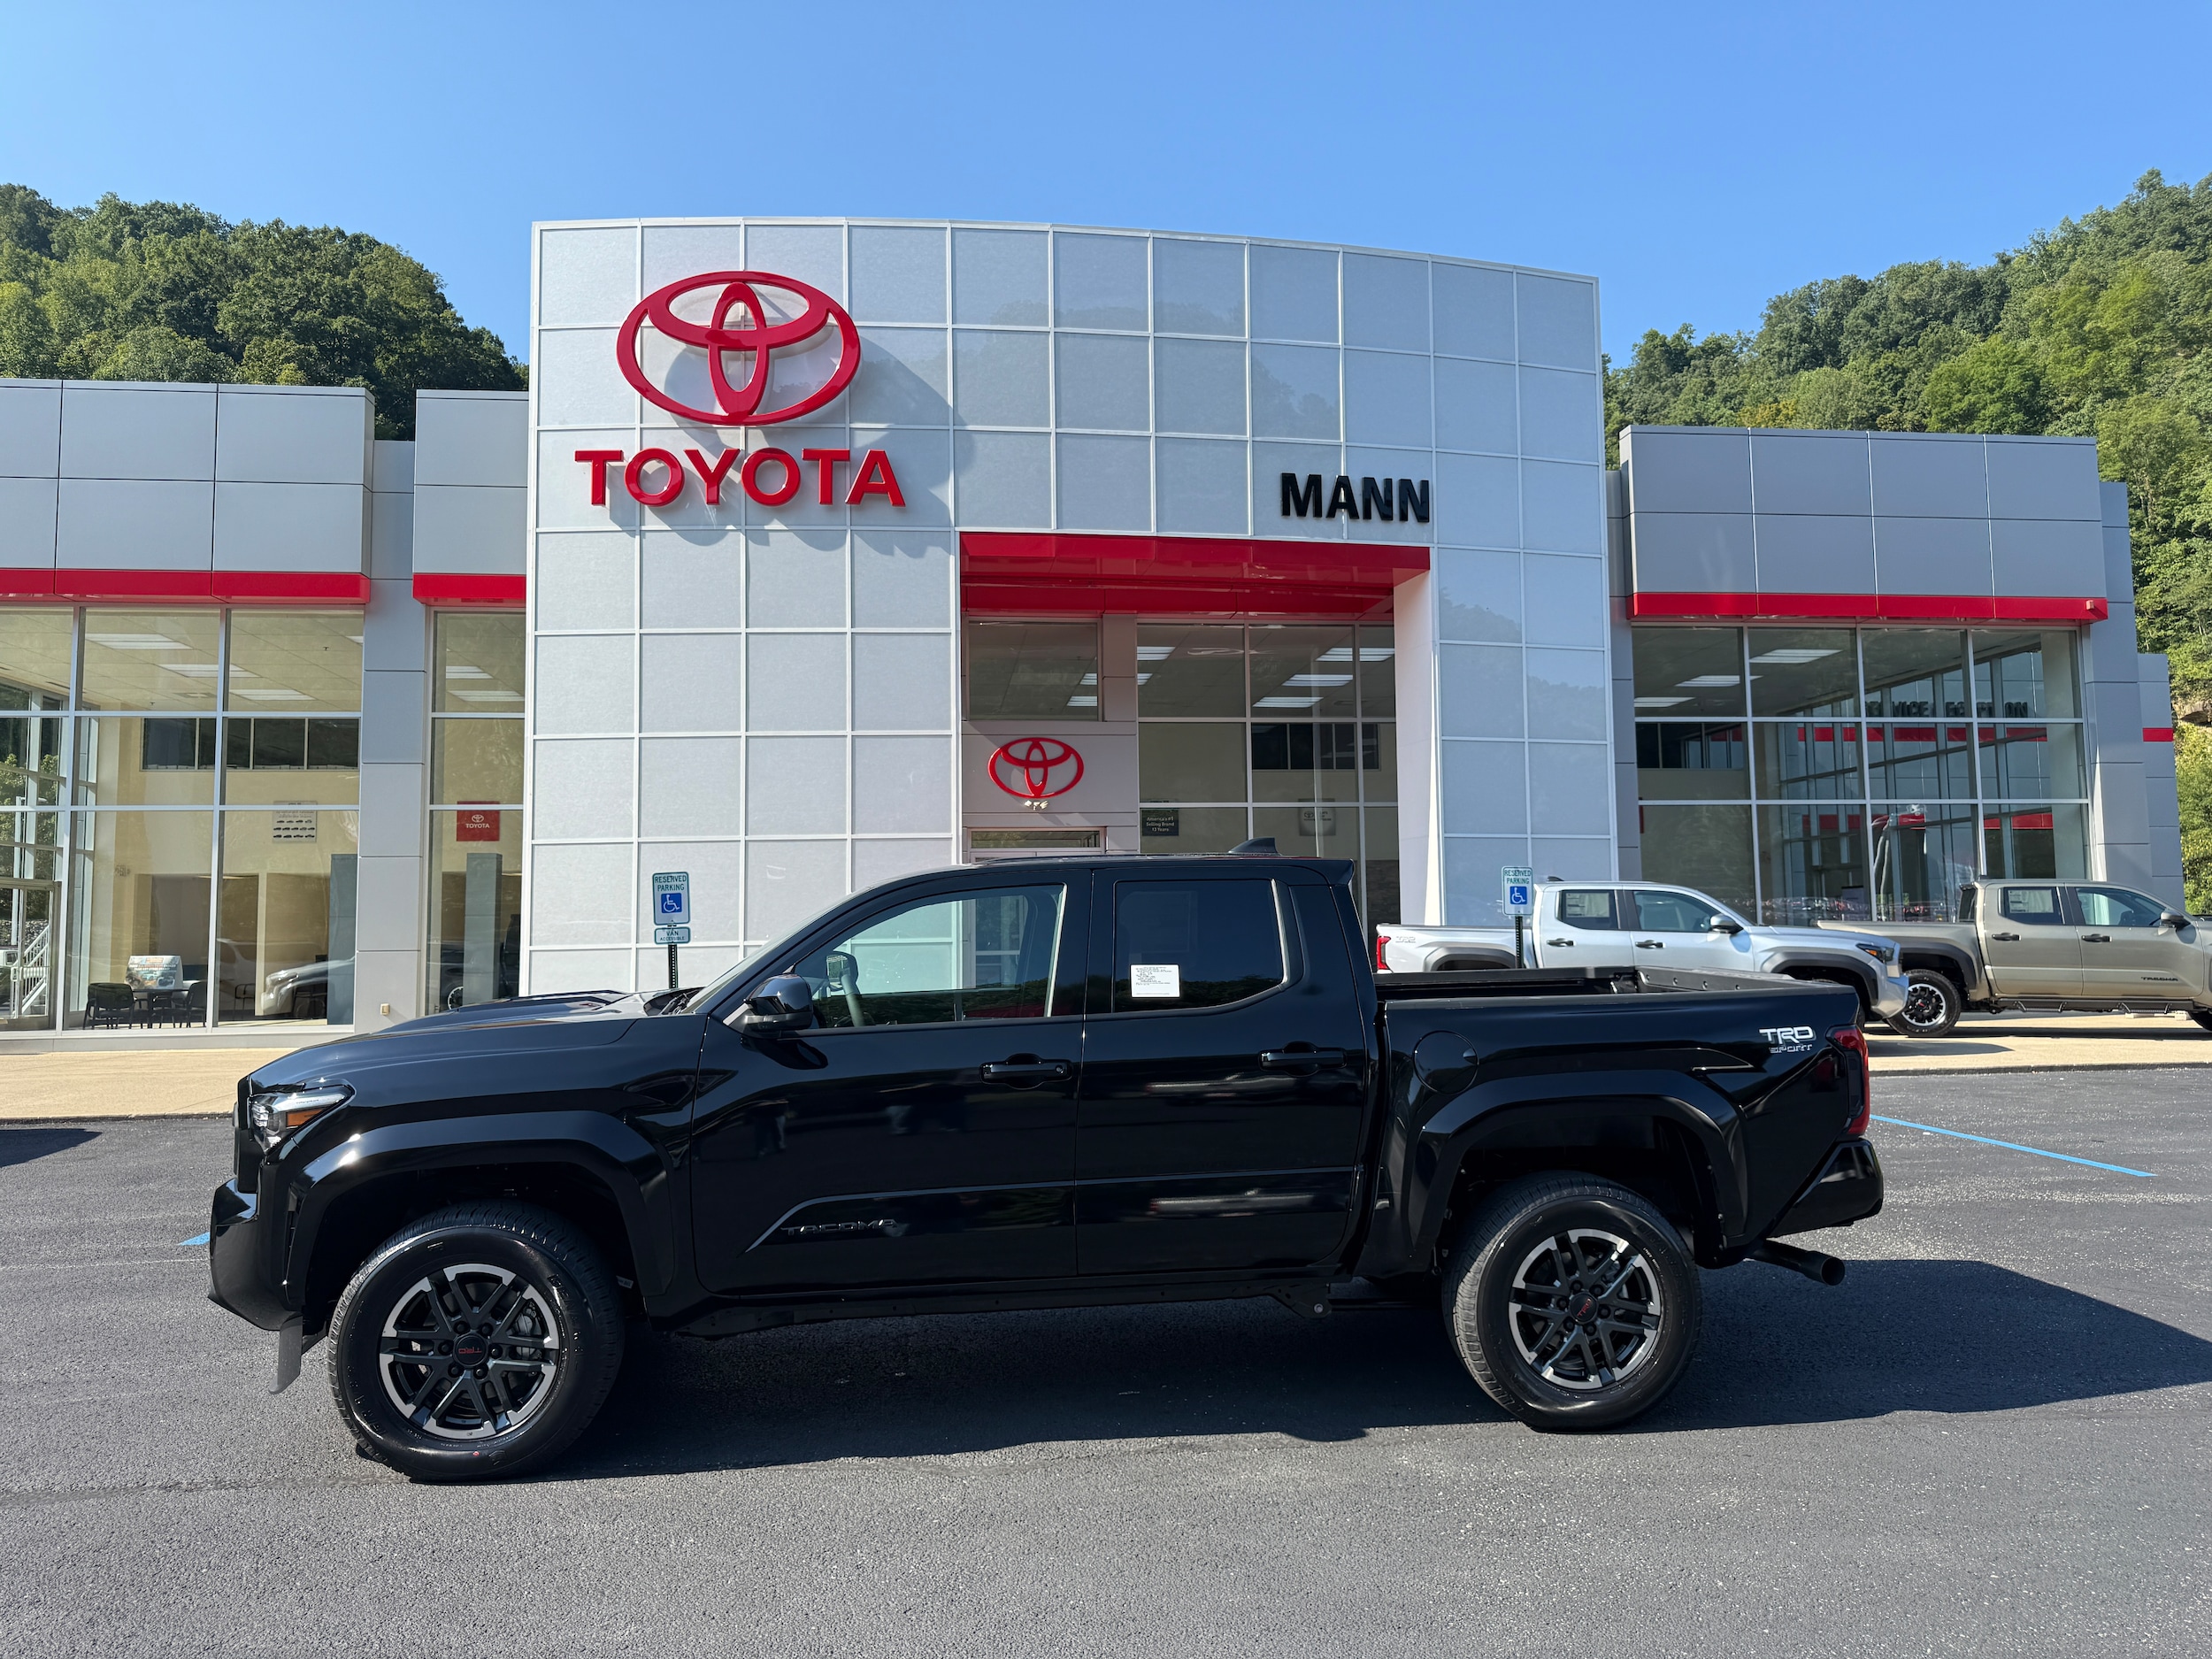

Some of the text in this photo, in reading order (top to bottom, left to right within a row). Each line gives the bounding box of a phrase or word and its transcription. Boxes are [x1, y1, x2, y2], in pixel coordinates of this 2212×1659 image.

[574, 447, 906, 508] TOYOTA
[1281, 472, 1430, 523] MANN
[1863, 701, 1929, 718] EVICE
[1759, 1026, 1815, 1044] TRD
[1769, 1044, 1813, 1054] SPORT
[780, 1218, 898, 1236] TACOMA
[458, 1346, 482, 1355] TRD
